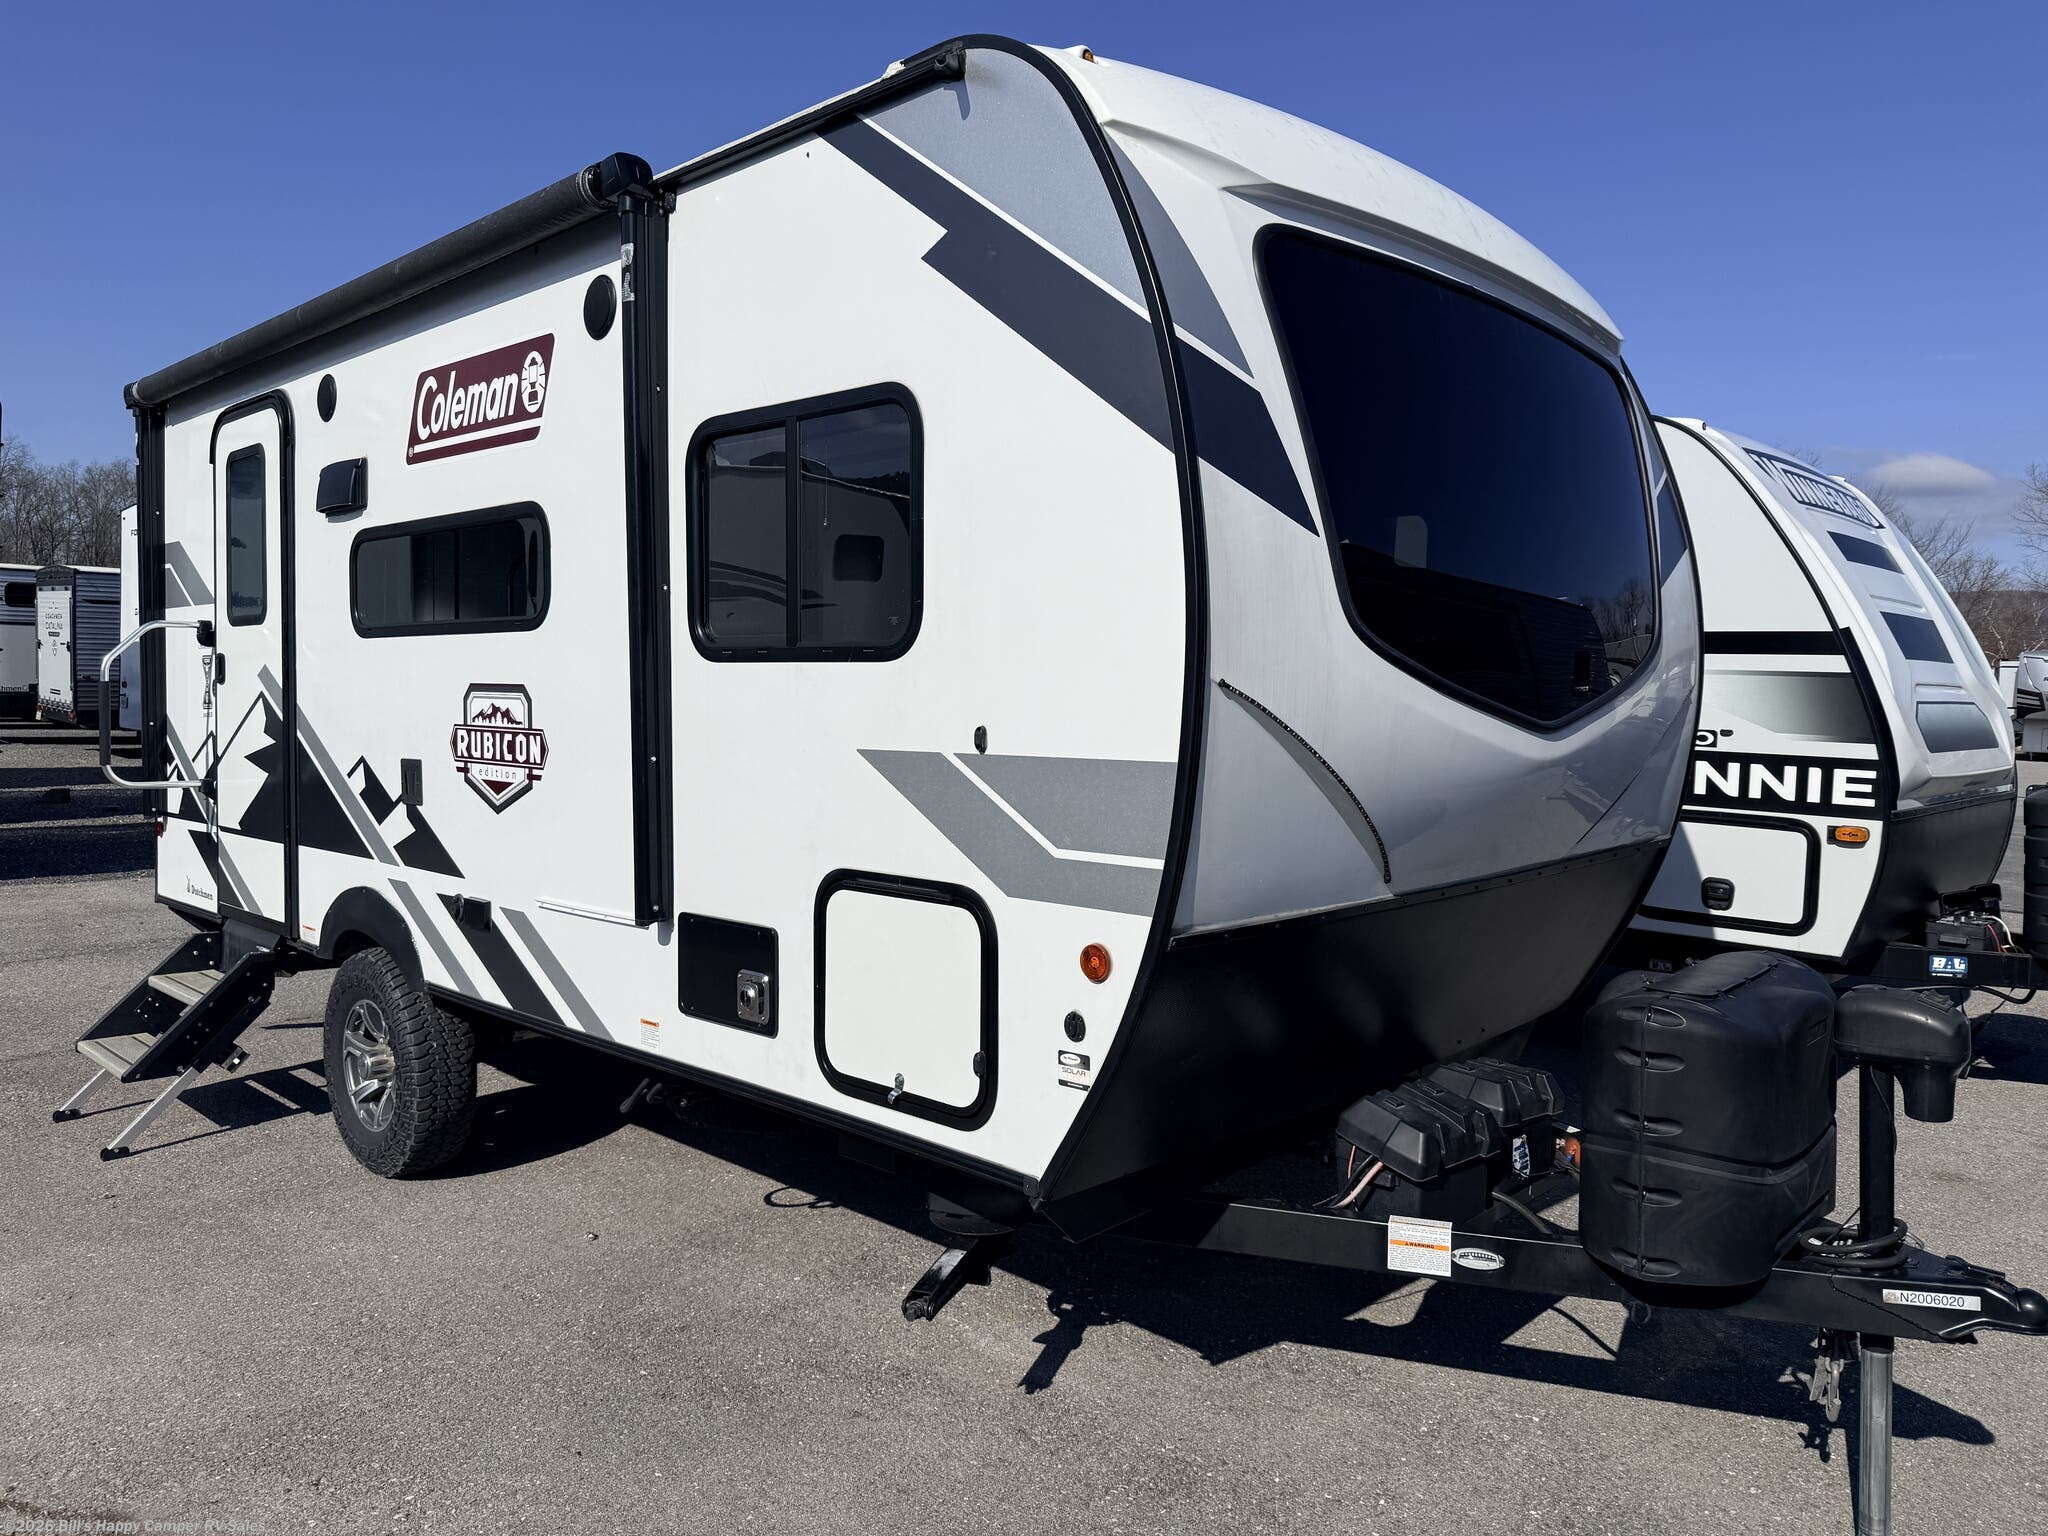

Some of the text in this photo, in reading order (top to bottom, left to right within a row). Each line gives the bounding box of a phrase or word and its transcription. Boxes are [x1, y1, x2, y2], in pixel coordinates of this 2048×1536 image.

[416, 370, 519, 441] Coleman
[456, 729, 541, 764] RUBICON
[478, 767, 517, 780] edition
[1061, 1067, 1086, 1077] SOLAR
[1409, 1242, 1435, 1250] WARNING
[1900, 1292, 1965, 1308] N2006020
